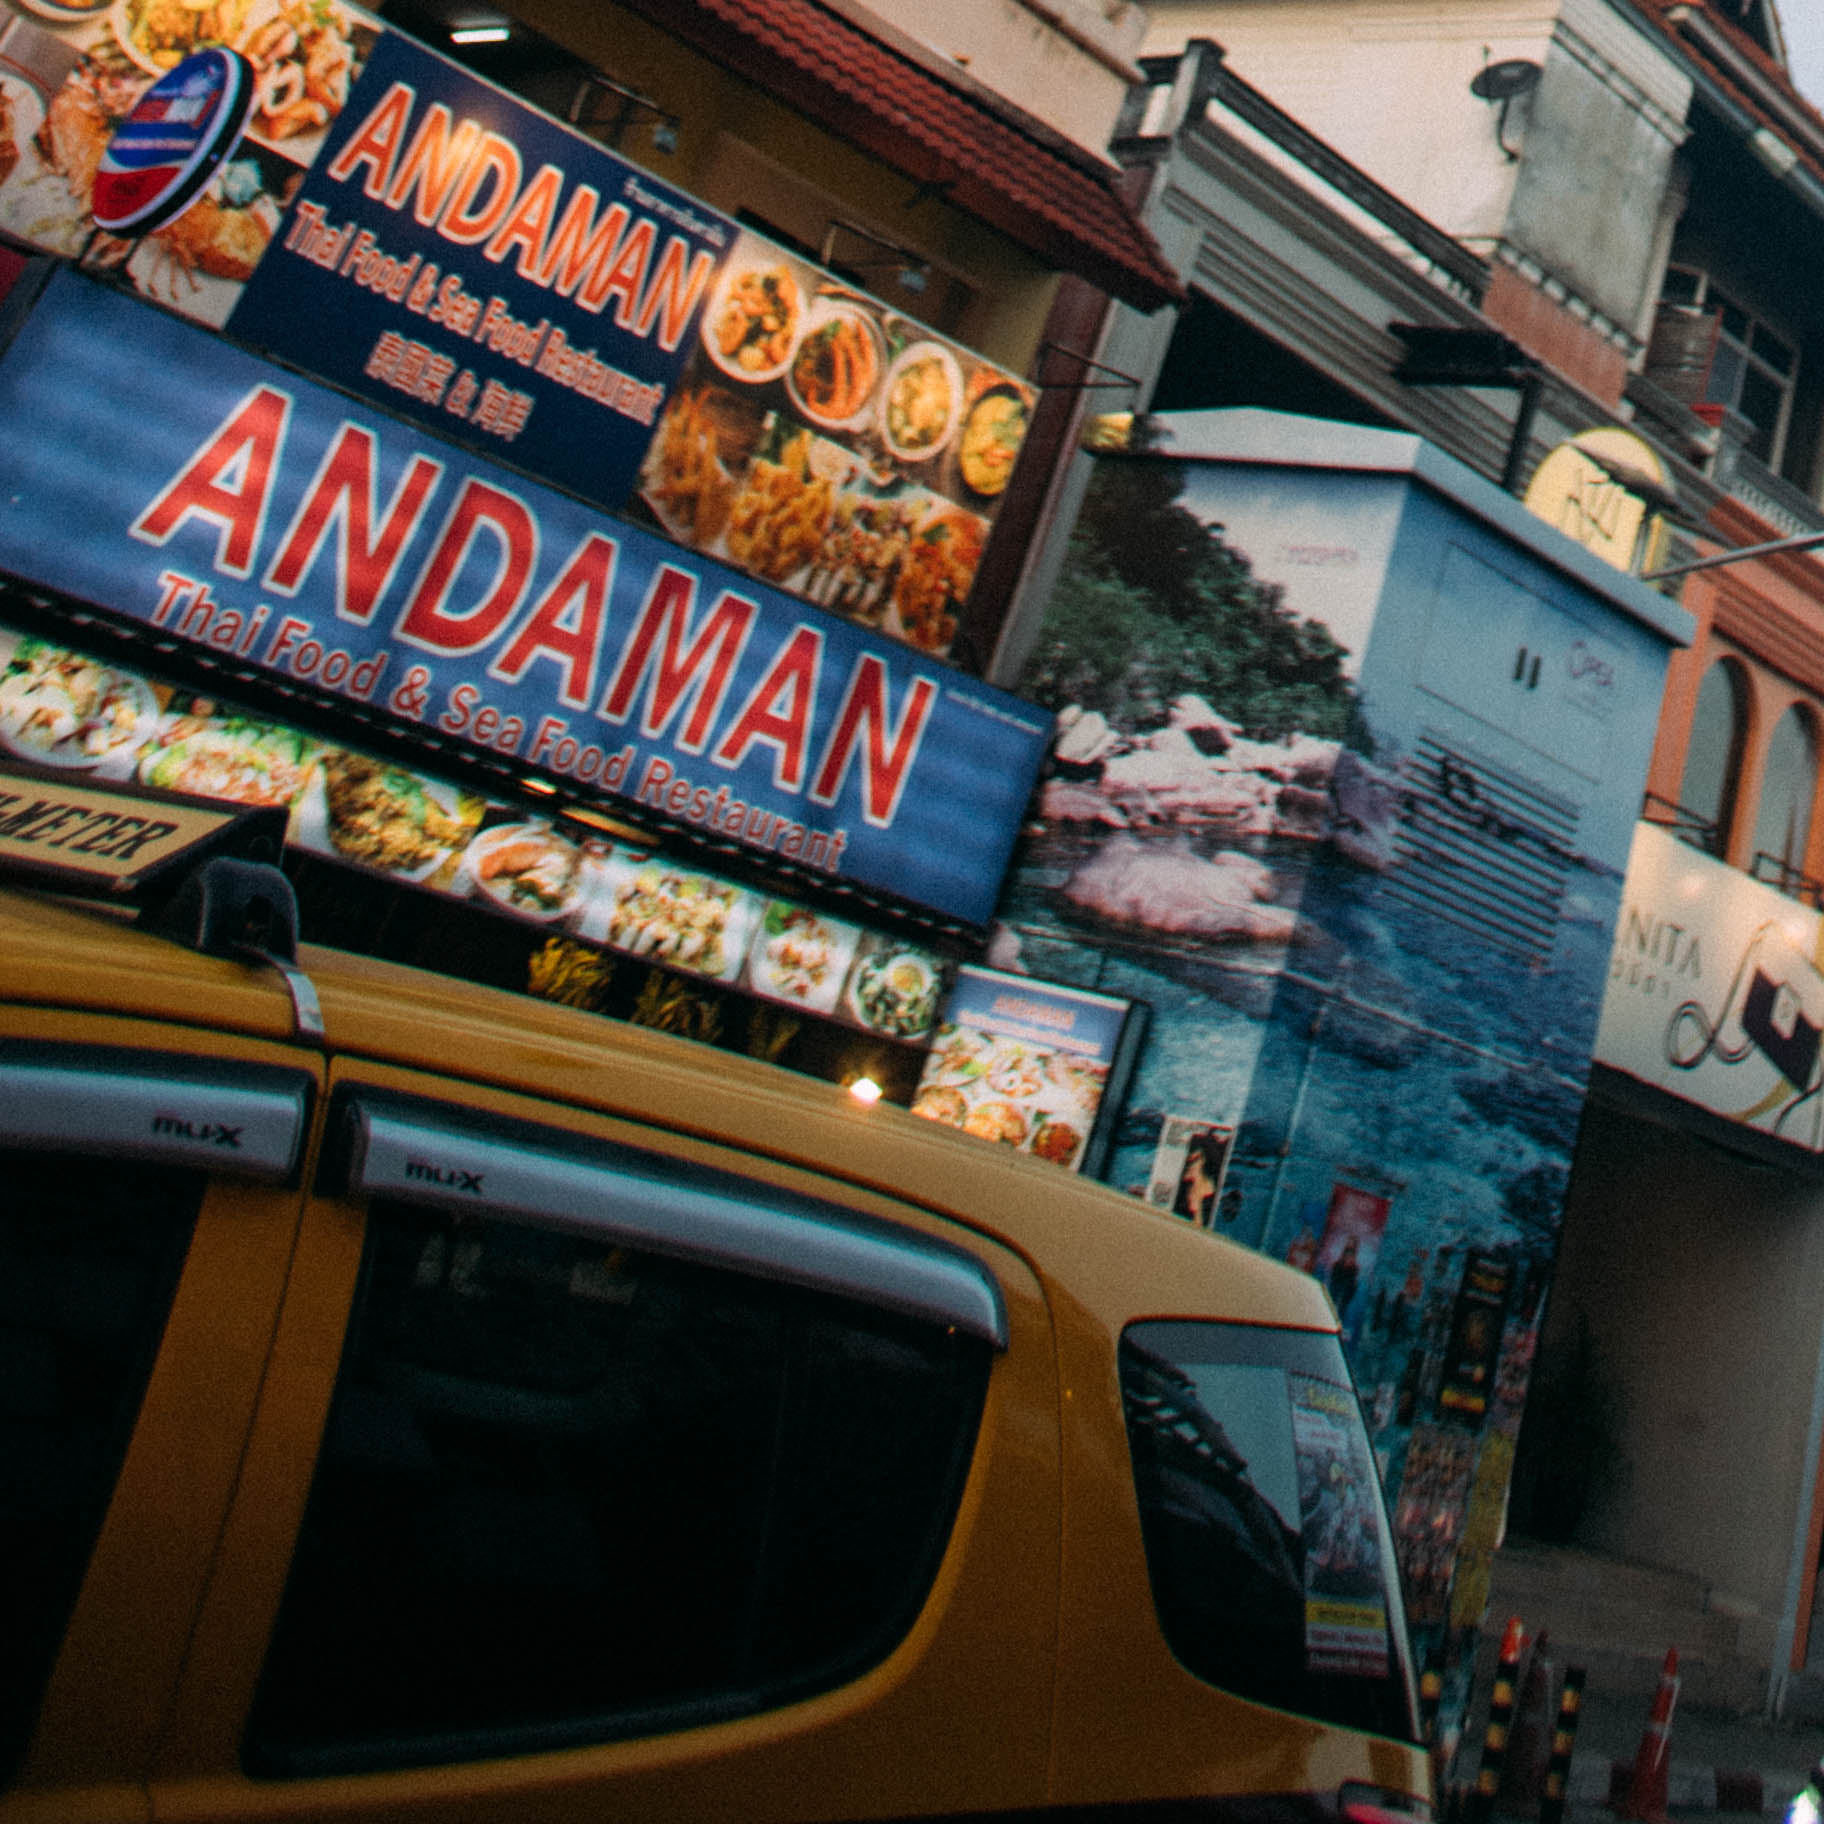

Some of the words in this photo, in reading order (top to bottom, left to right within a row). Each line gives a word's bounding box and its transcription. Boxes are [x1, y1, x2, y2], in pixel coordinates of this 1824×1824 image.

[284, 199, 356, 275] Thai
[345, 228, 420, 305] Food
[410, 261, 439, 316] &
[431, 273, 479, 337] Sea
[474, 295, 548, 368] Food
[536, 319, 667, 427] Restaurant
[328, 80, 714, 354] ANDAMAN
[128, 383, 940, 829] ANDAMAN
[150, 569, 272, 654] Thai
[267, 617, 388, 701] Food
[391, 665, 432, 720] &
[439, 684, 523, 754] Sea
[529, 715, 638, 793] Food
[633, 755, 848, 874] Restaurant
